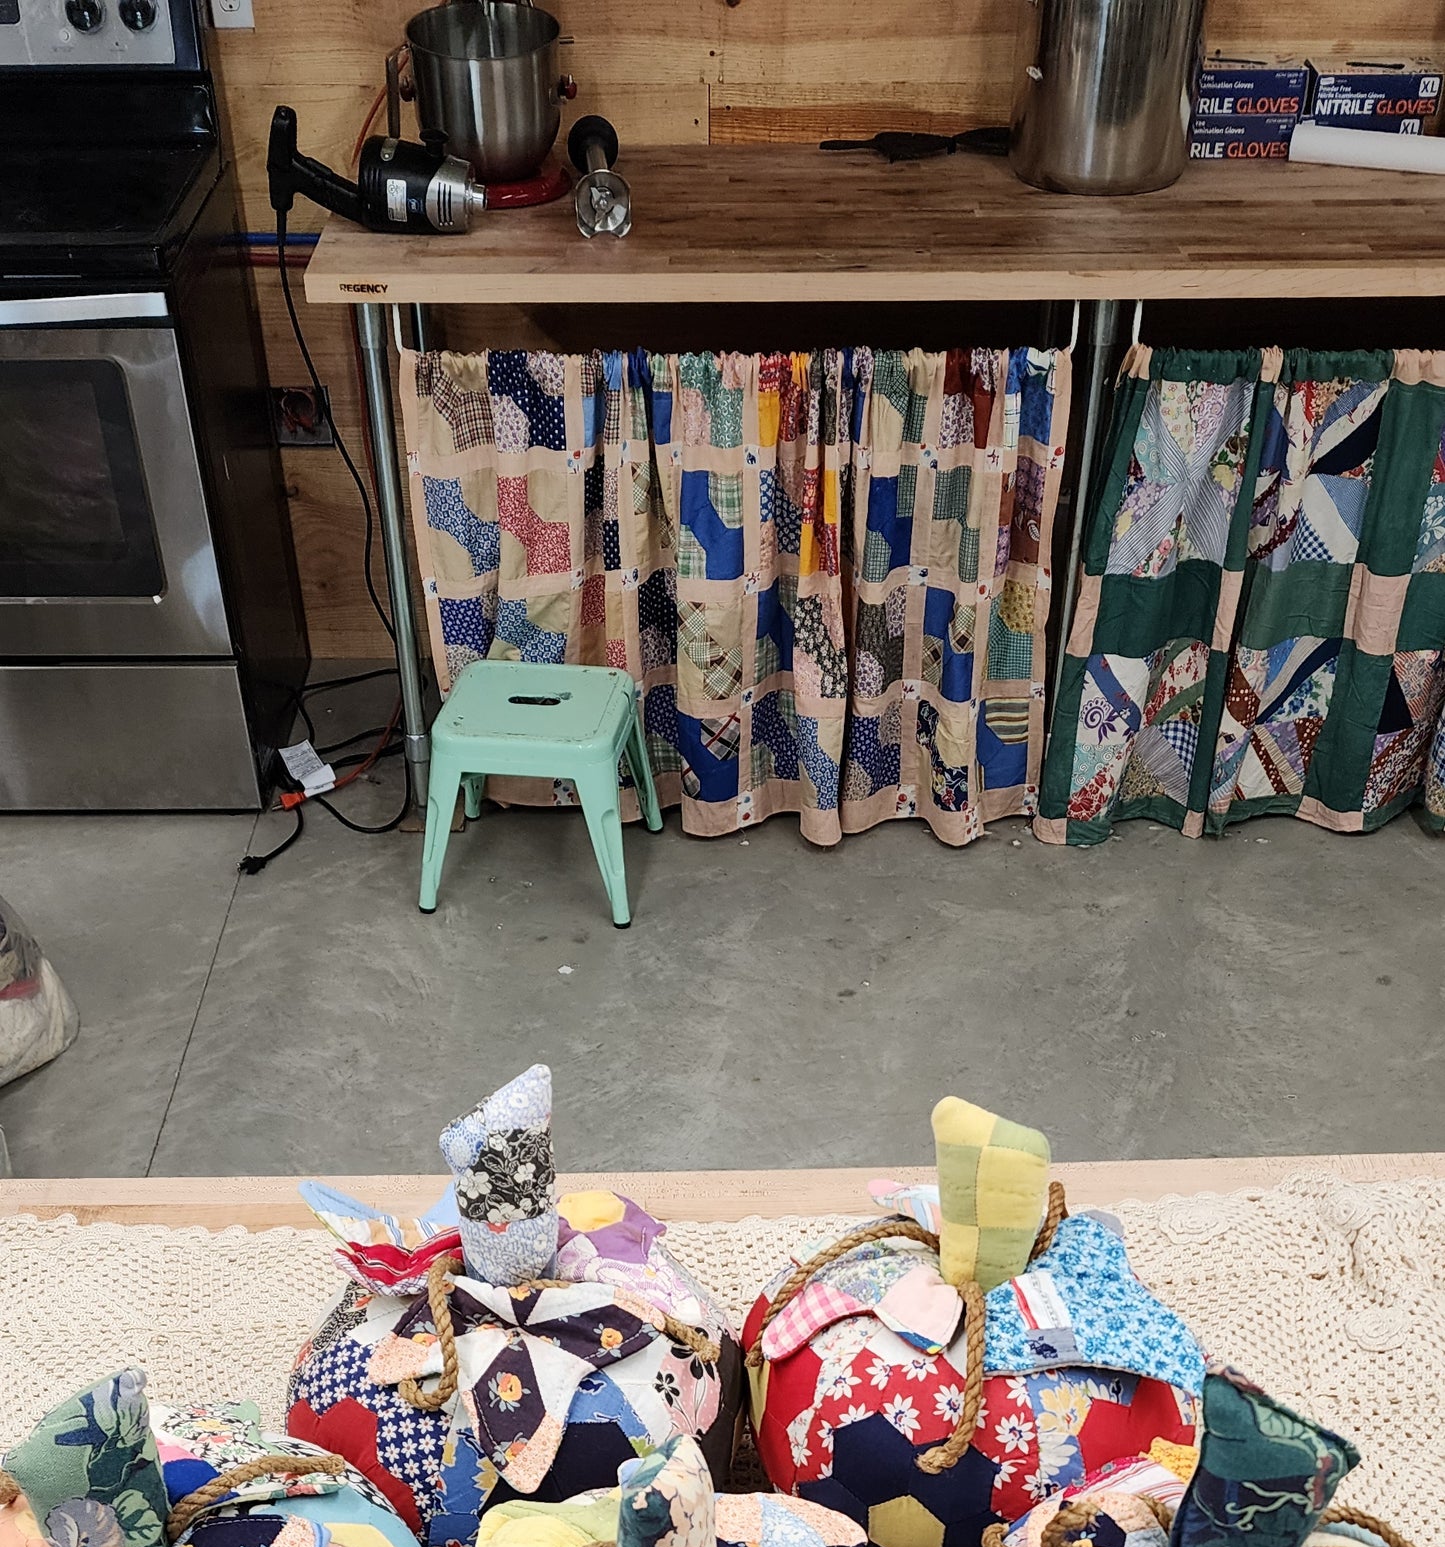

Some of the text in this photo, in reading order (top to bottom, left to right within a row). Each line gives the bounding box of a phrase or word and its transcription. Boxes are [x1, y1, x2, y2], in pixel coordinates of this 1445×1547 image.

[1234, 80, 1255, 89] Gloves
[1420, 79, 1437, 94] XL
[1236, 97, 1299, 114] GLOVES
[1315, 99, 1437, 115] NITRILE GLOVES
[1401, 121, 1418, 135] XL
[1227, 142, 1289, 158] GLOVES
[339, 283, 388, 294] REGENCY
